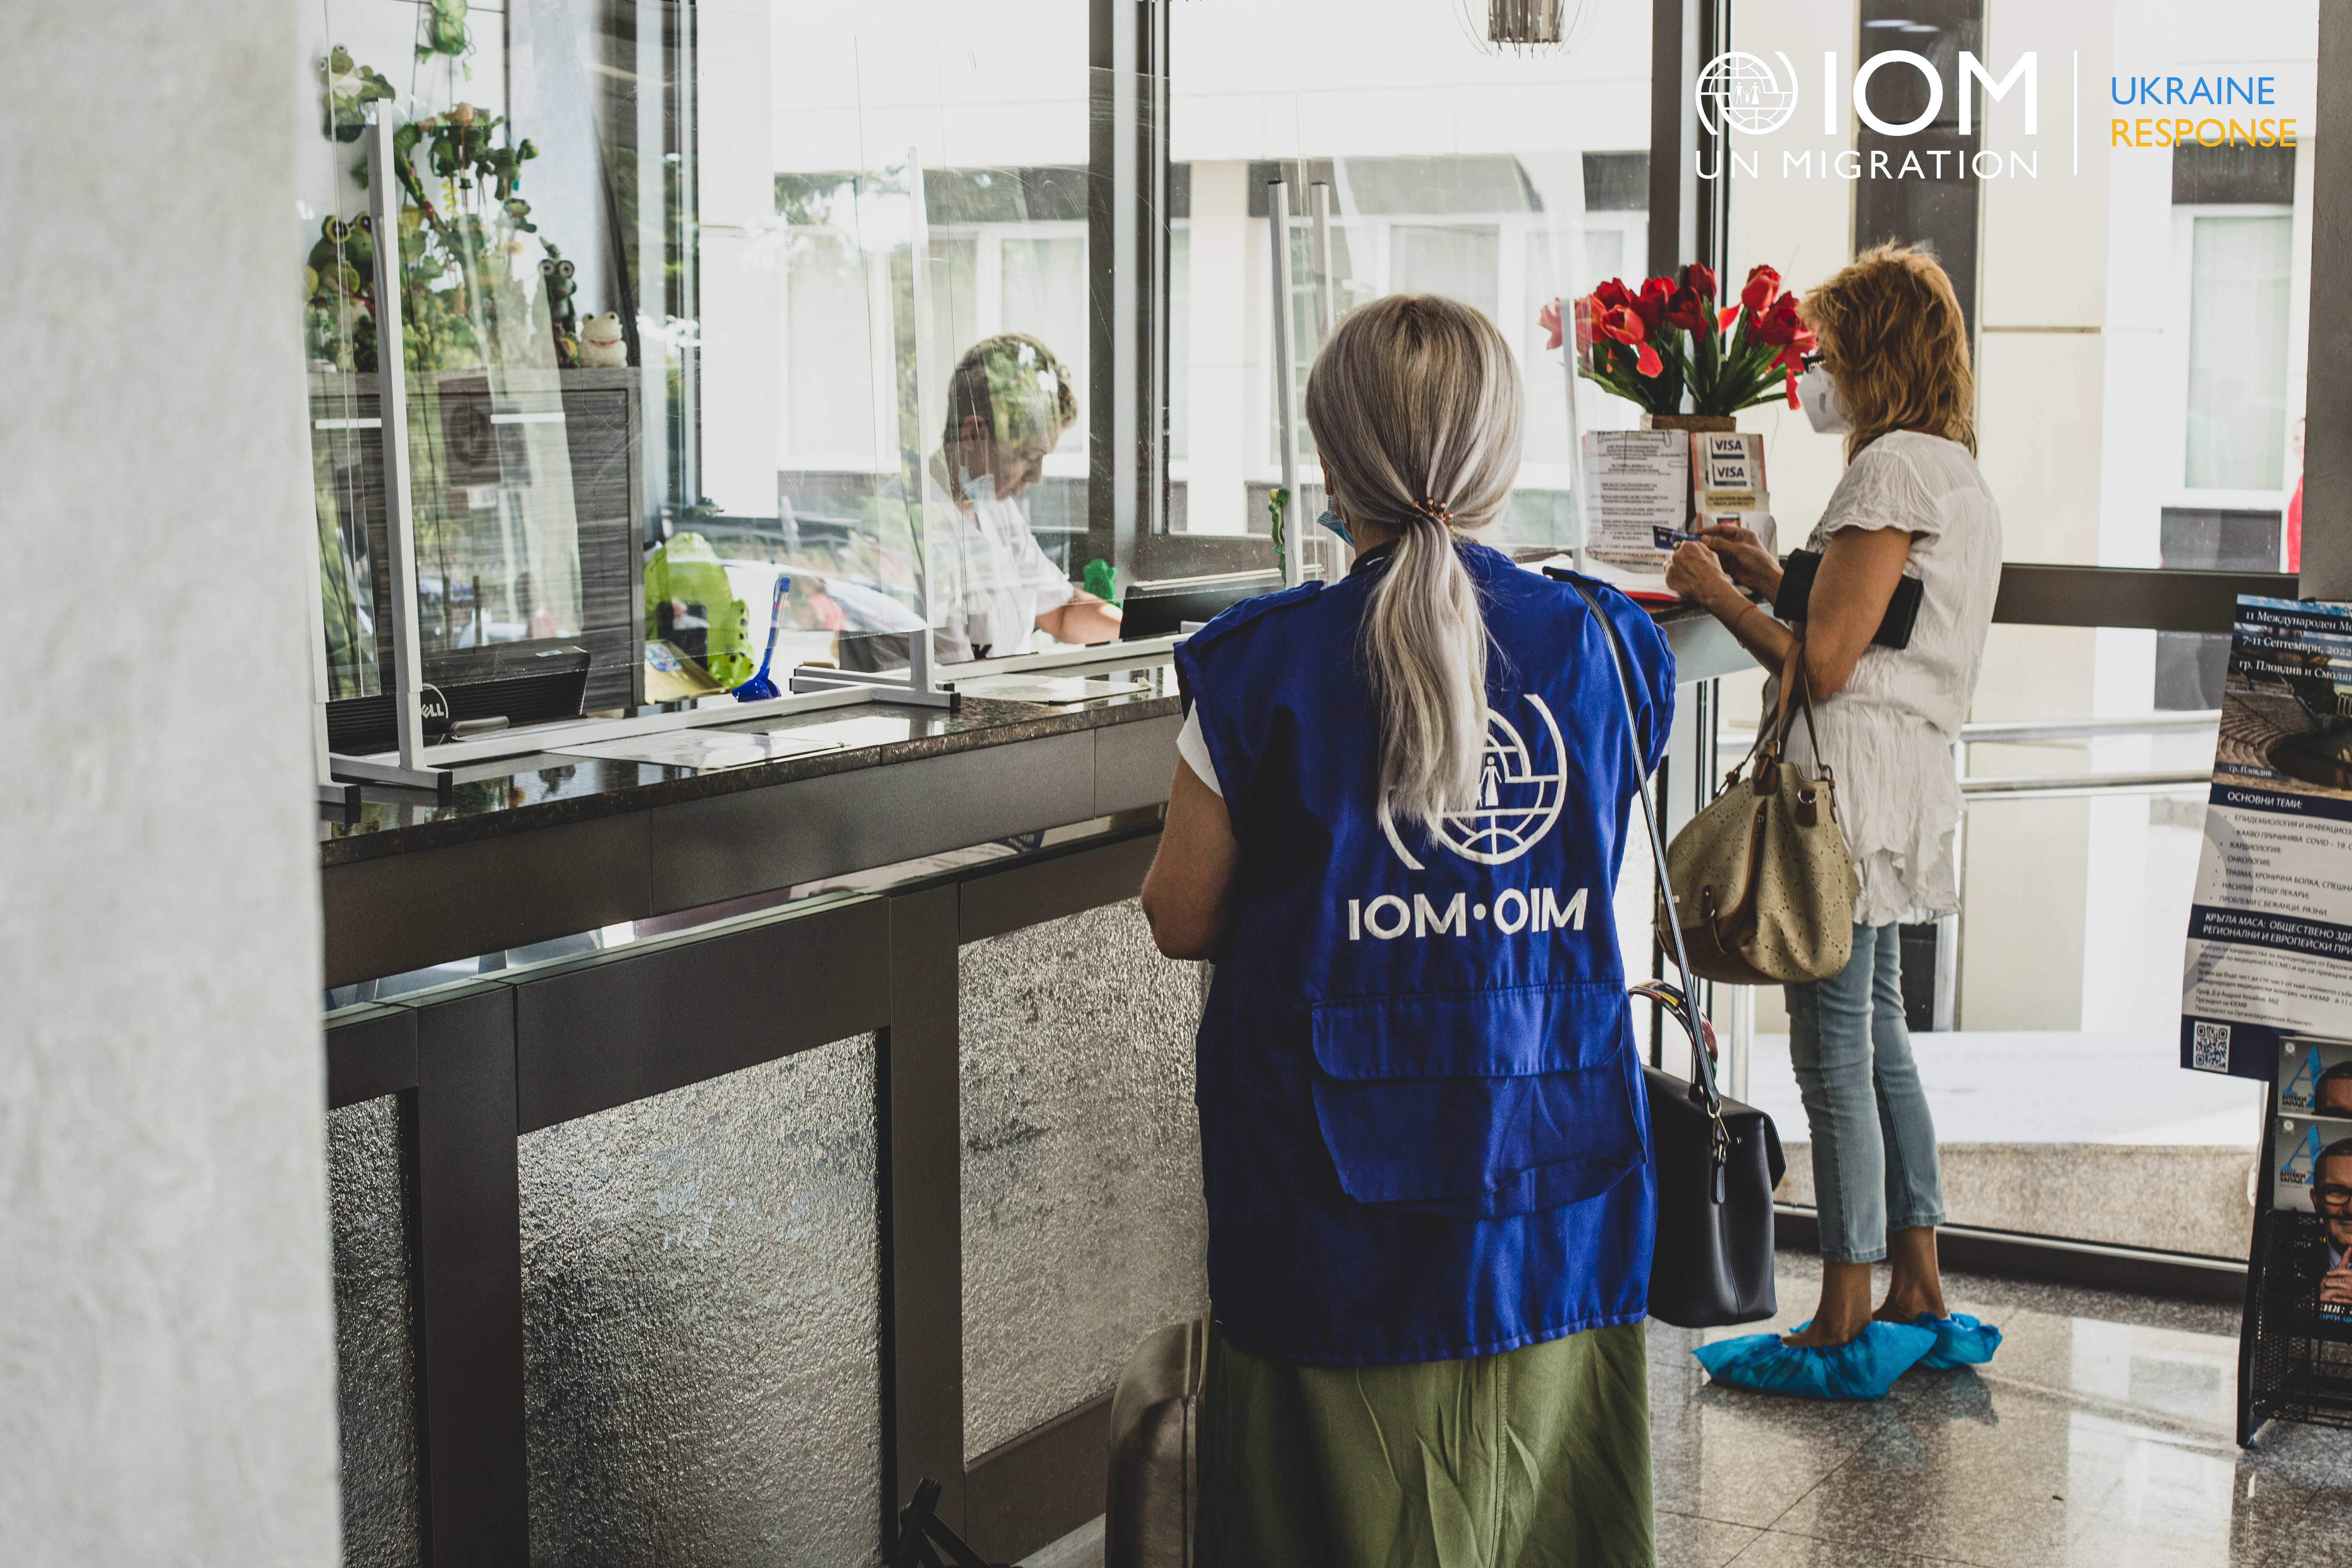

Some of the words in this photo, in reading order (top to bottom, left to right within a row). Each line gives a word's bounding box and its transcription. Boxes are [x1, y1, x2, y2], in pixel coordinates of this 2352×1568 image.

[1715, 440, 1742, 450] VISA
[1717, 467, 1744, 477] VISA
[2257, 611, 2336, 629] Международен
[2327, 646, 2352, 656] 2022
[2239, 660, 2252, 671] гр.
[2257, 660, 2302, 676] Пловдив
[2305, 668, 2311, 677] и
[421, 703, 444, 719] ELL
[2227, 791, 2274, 806] ОСНОВНИ
[2276, 797, 2302, 809] ТЕМИ:
[2235, 815, 2297, 828] ЕПИДЕМИОЛОГИЯ
[2306, 821, 2352, 836] ИНФЕКЦИОЗ
[2236, 829, 2260, 837] КАКВО
[2261, 832, 2303, 842] ПРИЧИНЯВА
[2306, 838, 2329, 847] COVID
[2255, 871, 2292, 882] ХРОНИЧНА
[2222, 882, 2254, 891] НАСИЛИЕ
[2256, 885, 2278, 895] СРЕЩУ
[2205, 912, 2236, 924] КРЪГЛА
[2239, 916, 2266, 929] МАСА:
[2269, 920, 2334, 939] ОБЩЕСТВЕНО
[2203, 925, 2260, 940] РЕГИОНАЛНИ
[2262, 932, 2269, 941] И
[2270, 933, 2332, 952] ЕВРОПЕЙСКИ
